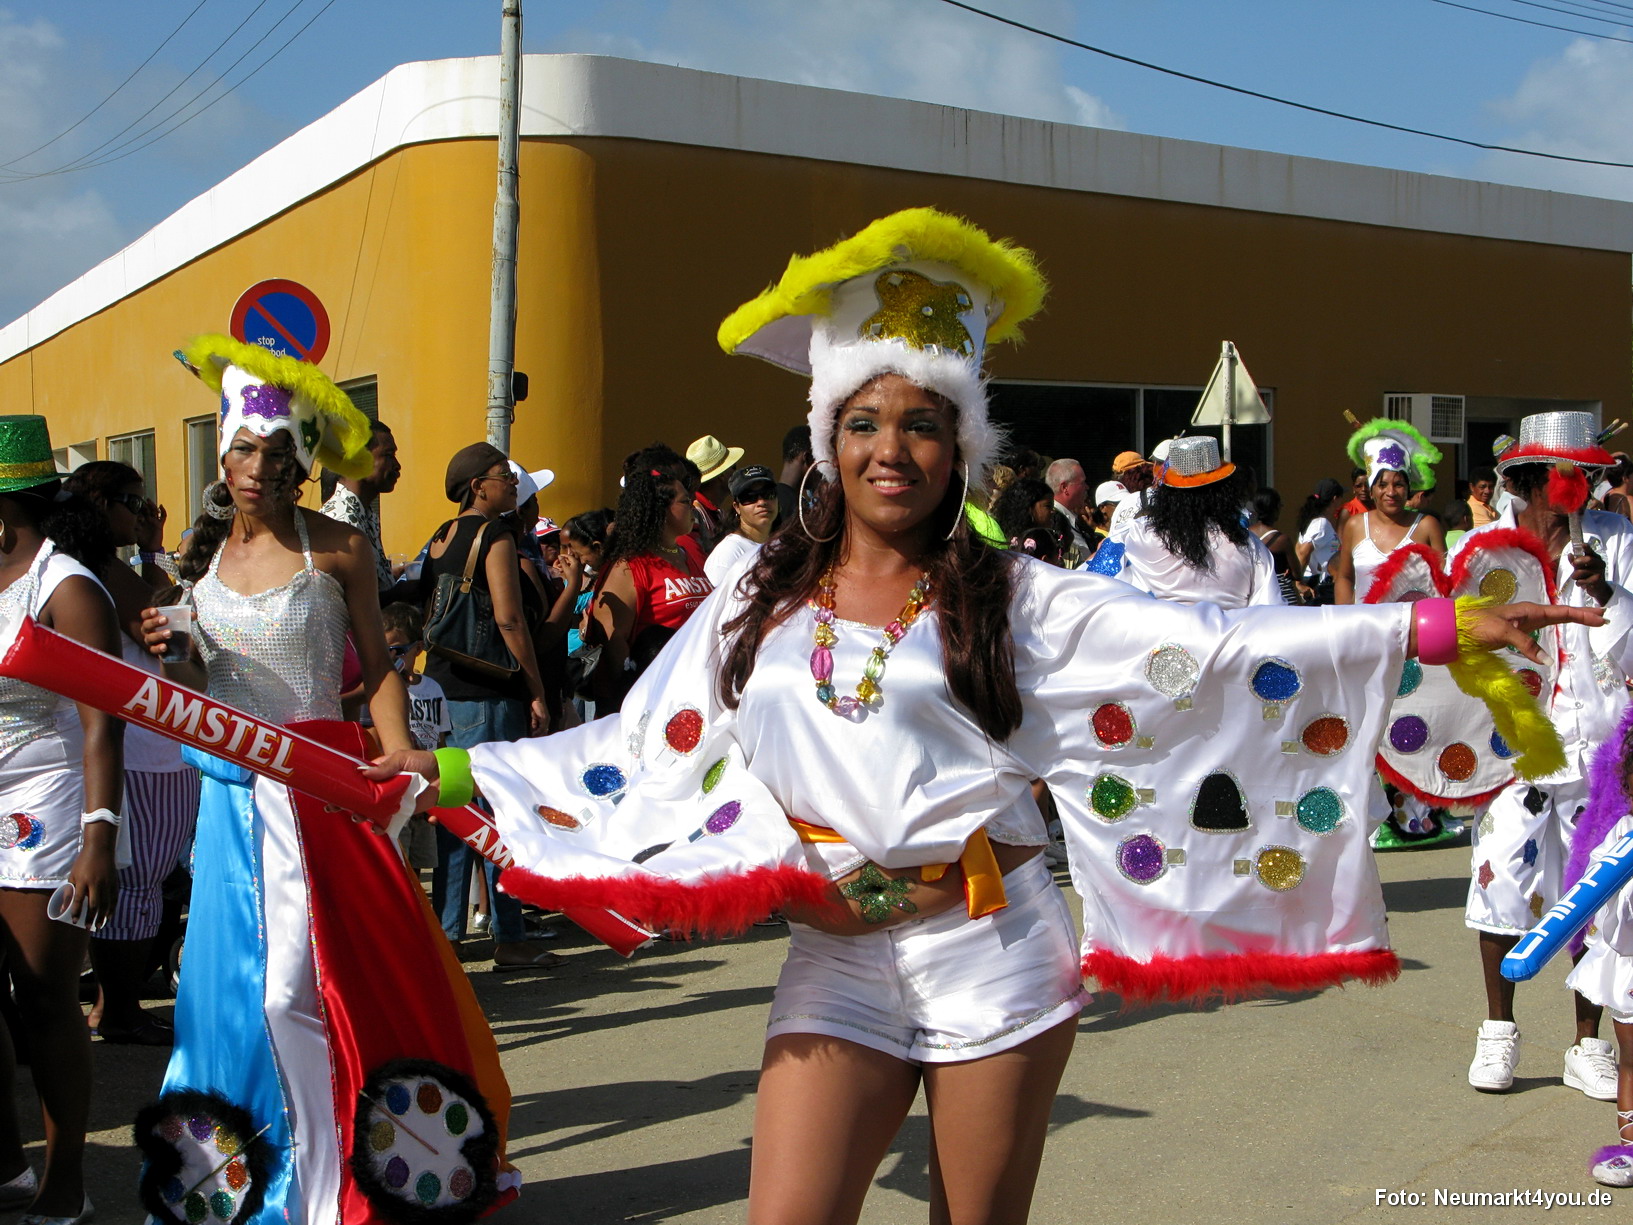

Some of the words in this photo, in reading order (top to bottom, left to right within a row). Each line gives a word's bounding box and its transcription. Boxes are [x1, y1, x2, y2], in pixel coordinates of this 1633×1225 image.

[257, 335, 276, 348] stop
[123, 676, 295, 776] AMSTEL
[1504, 836, 1633, 960] CHIPPIE
